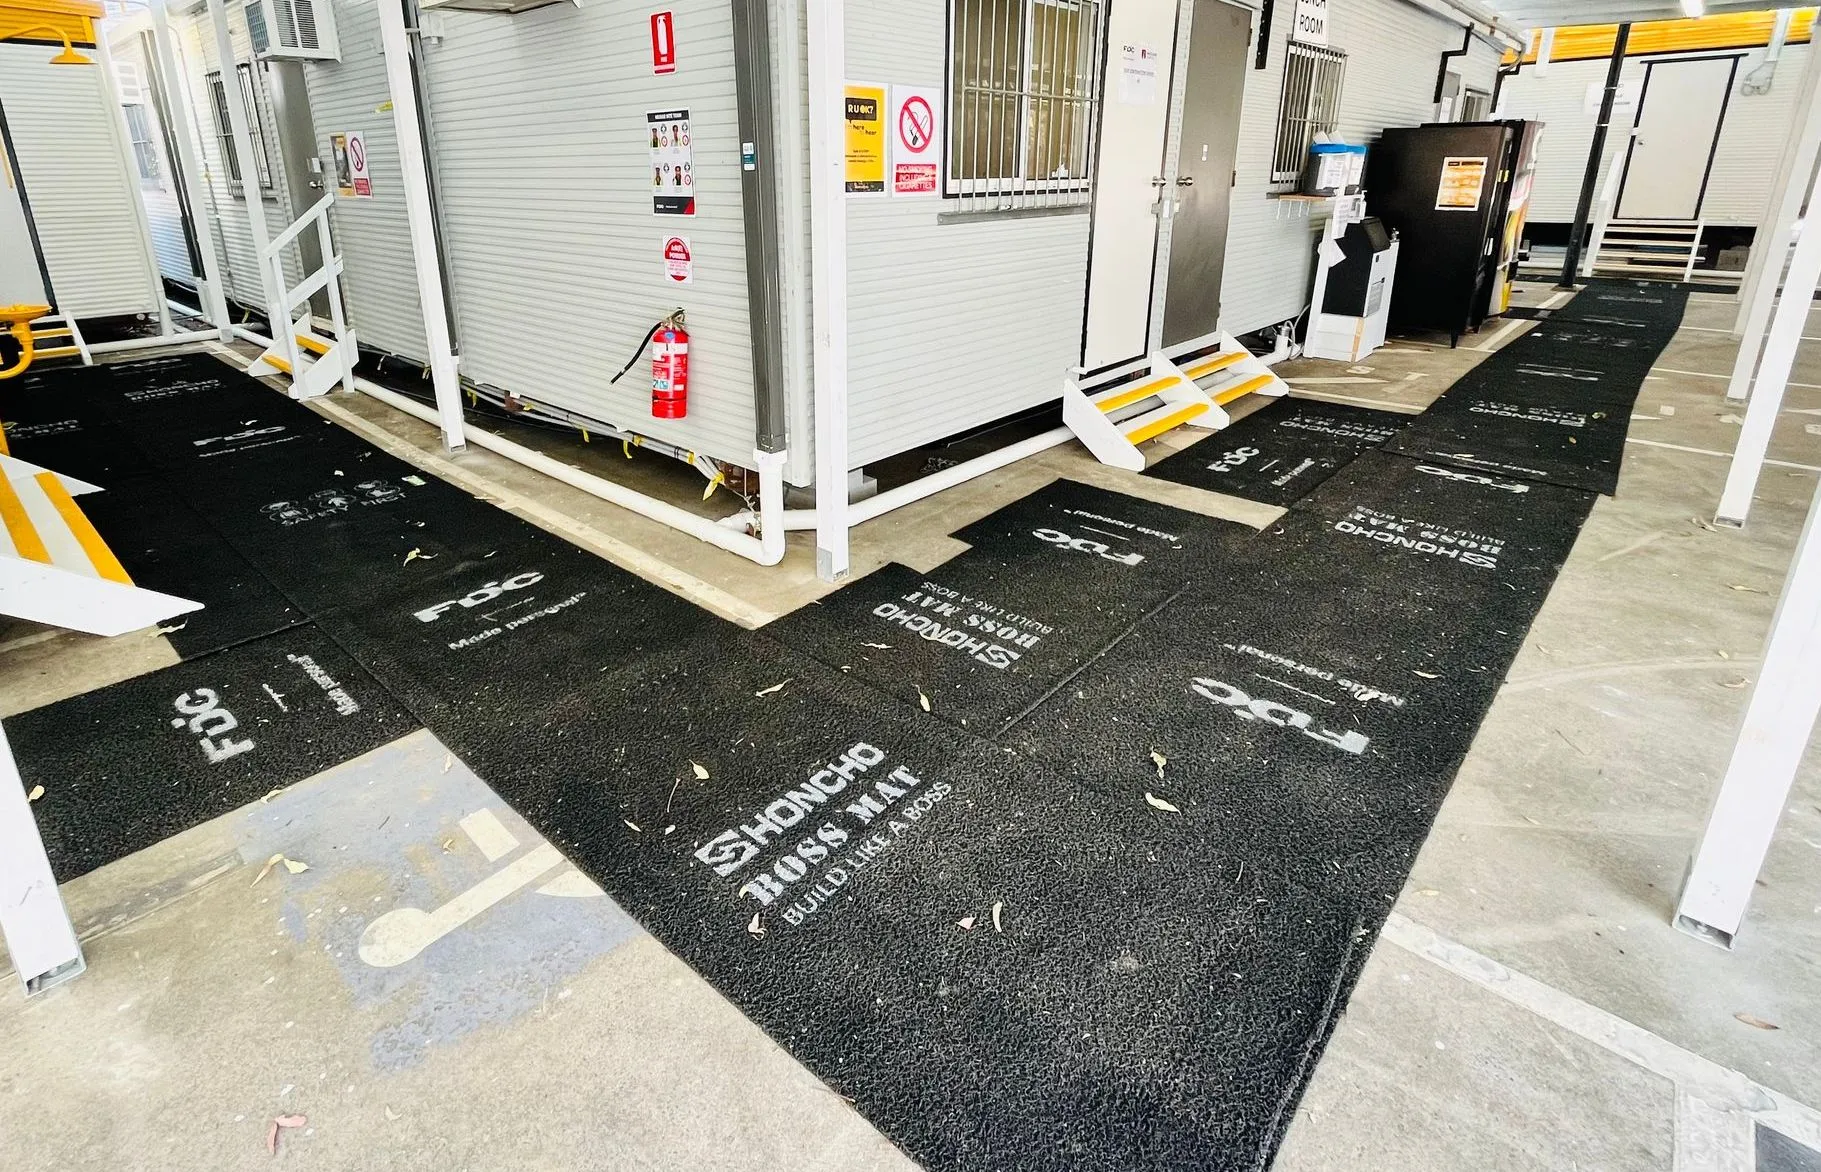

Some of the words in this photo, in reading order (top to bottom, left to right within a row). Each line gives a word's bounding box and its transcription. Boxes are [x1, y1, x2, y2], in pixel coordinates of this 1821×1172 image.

[1300, 14, 1323, 35] ROOM
[1206, 446, 1260, 473] FDC
[1032, 528, 1145, 566] FDC
[413, 572, 545, 623] FDC
[901, 591, 962, 617] MAT
[963, 614, 1042, 649] BOSS
[171, 688, 255, 764] FDC
[1191, 676, 1370, 755] FDC
[746, 822, 849, 906] BOSS
[846, 765, 921, 825] MAT
[782, 868, 849, 926] BUILD
[845, 831, 891, 868] LIKE
[888, 819, 910, 838] A
[902, 781, 952, 821] BOSS
